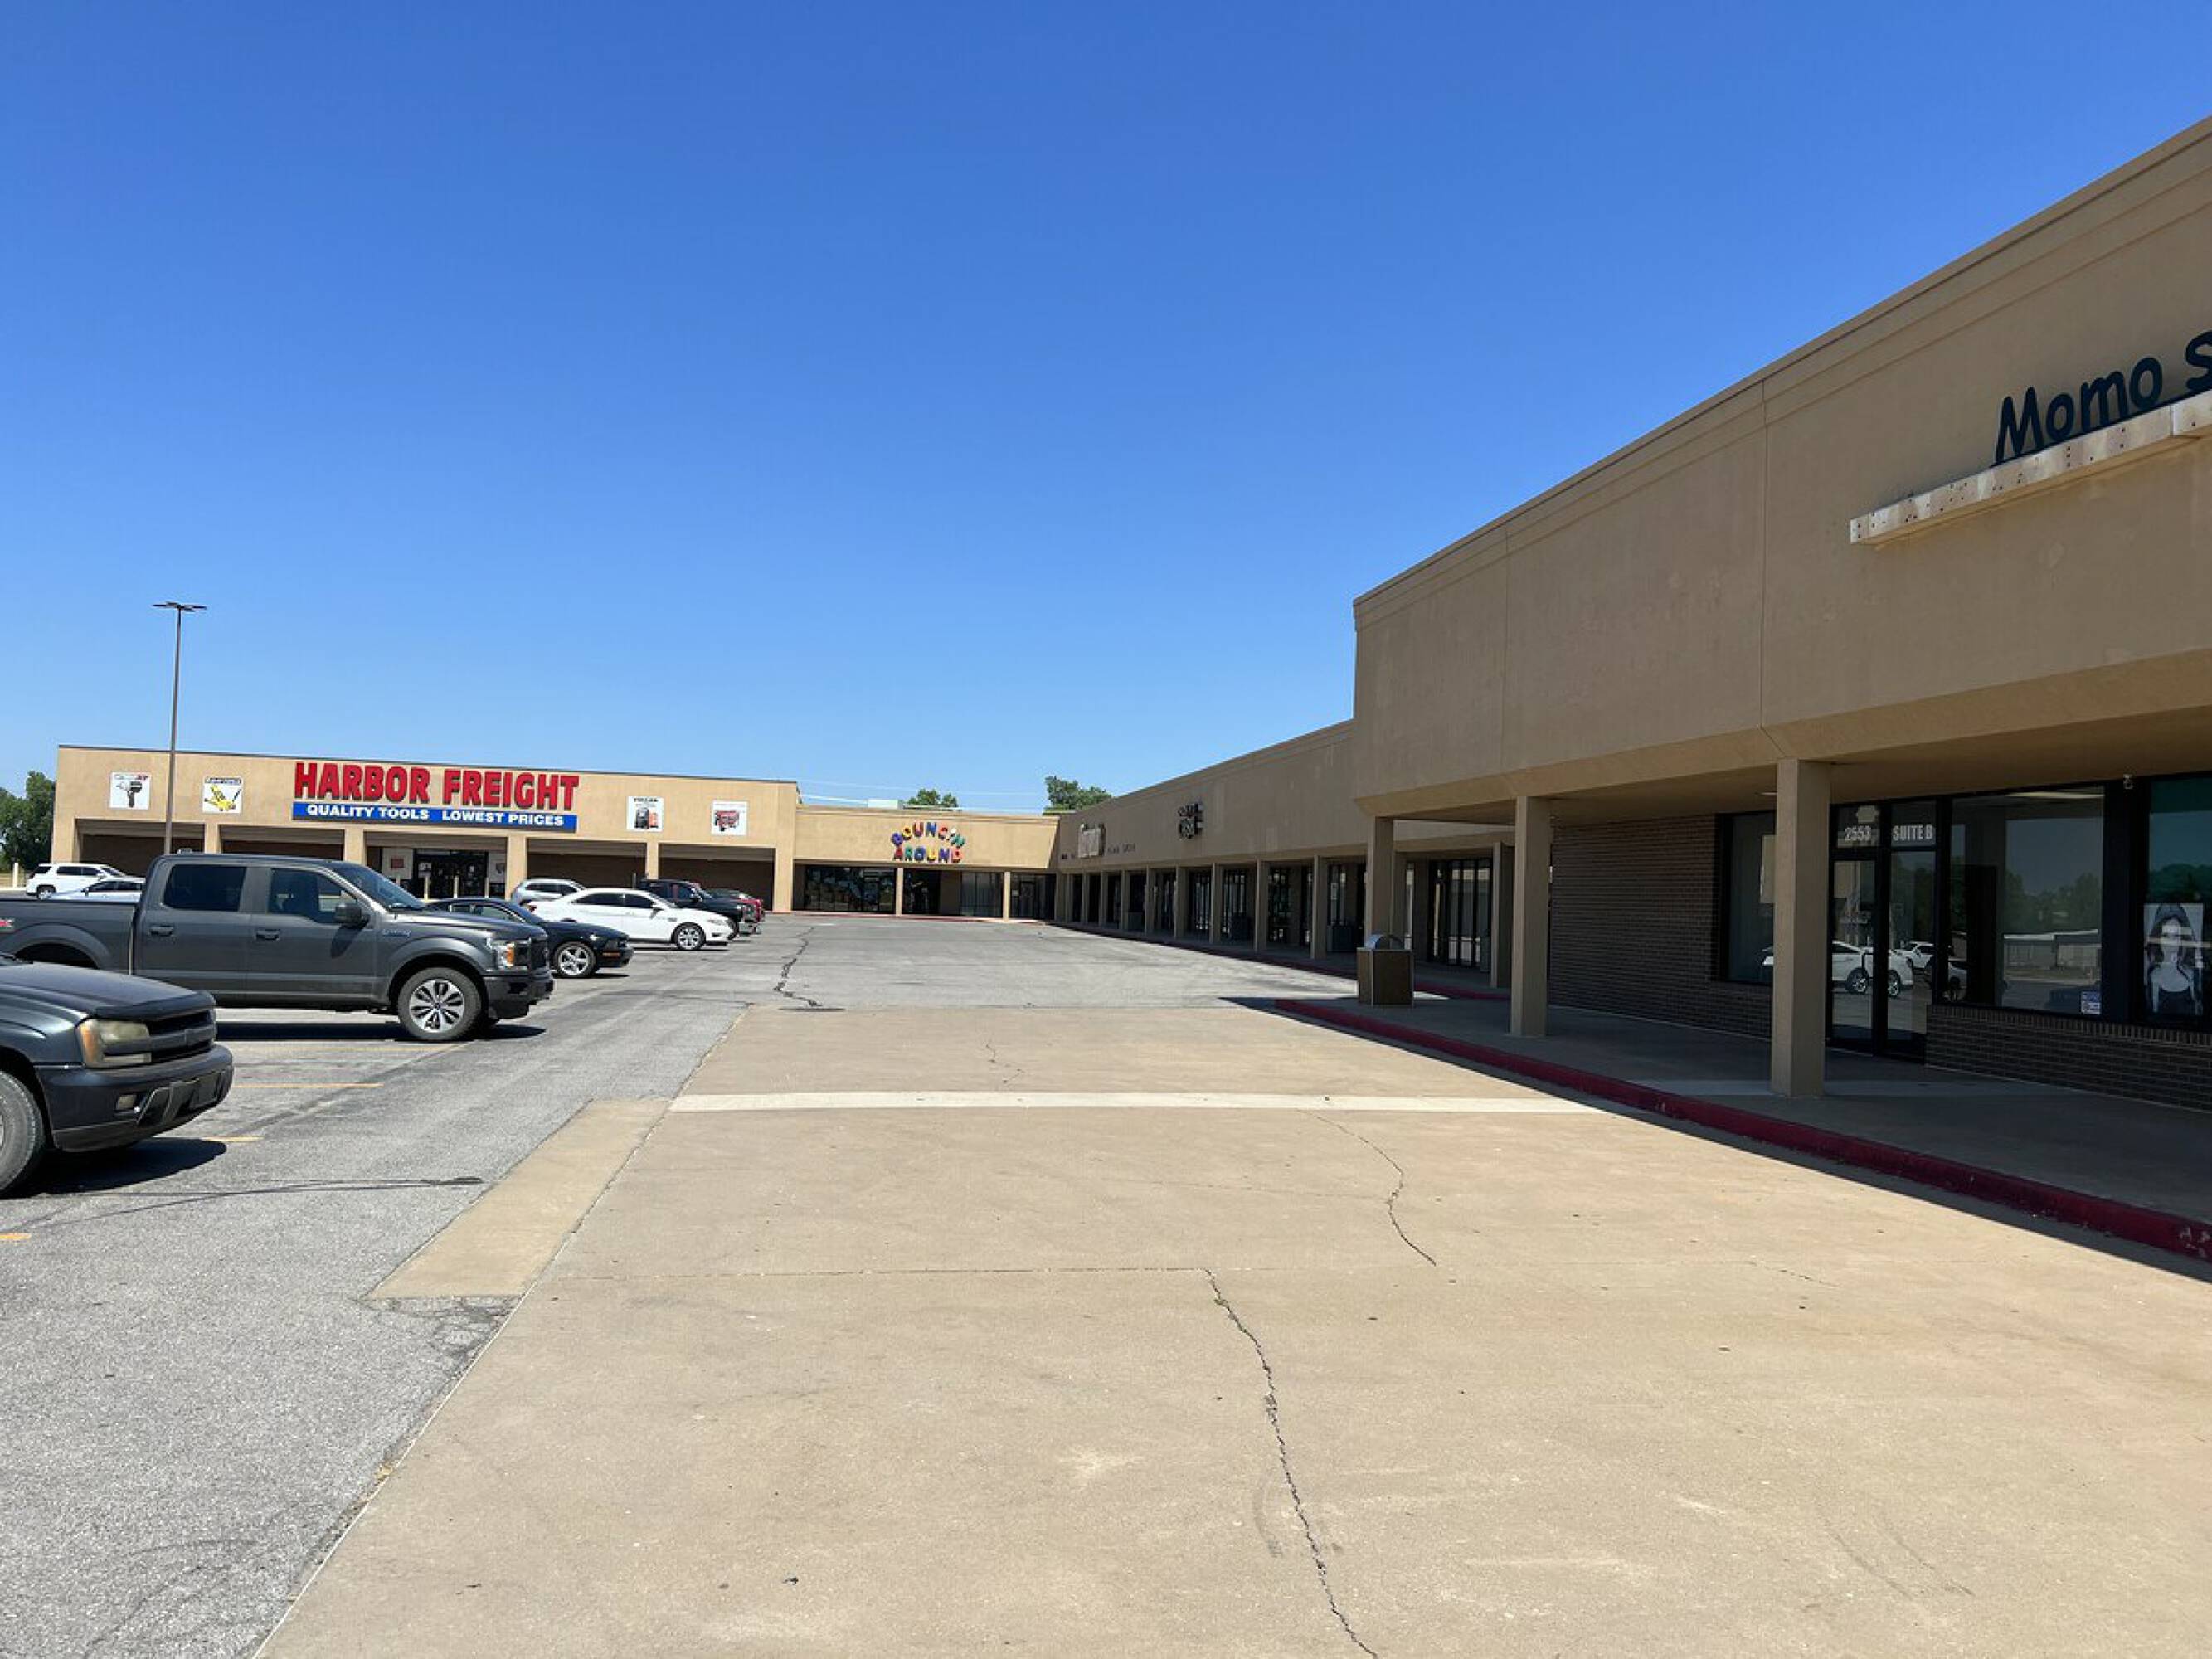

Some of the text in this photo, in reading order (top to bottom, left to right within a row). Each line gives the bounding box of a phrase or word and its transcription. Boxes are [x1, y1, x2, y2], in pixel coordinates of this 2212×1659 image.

[1996, 357, 2163, 464] Momo
[294, 761, 580, 811] HARBOR FREIGHT
[307, 805, 564, 827] QUALITY TOOLS LOWEST PRICES
[1845, 825, 1872, 842] 2553
[1892, 825, 1923, 842] SUITE
[894, 846, 963, 864] AROUND
